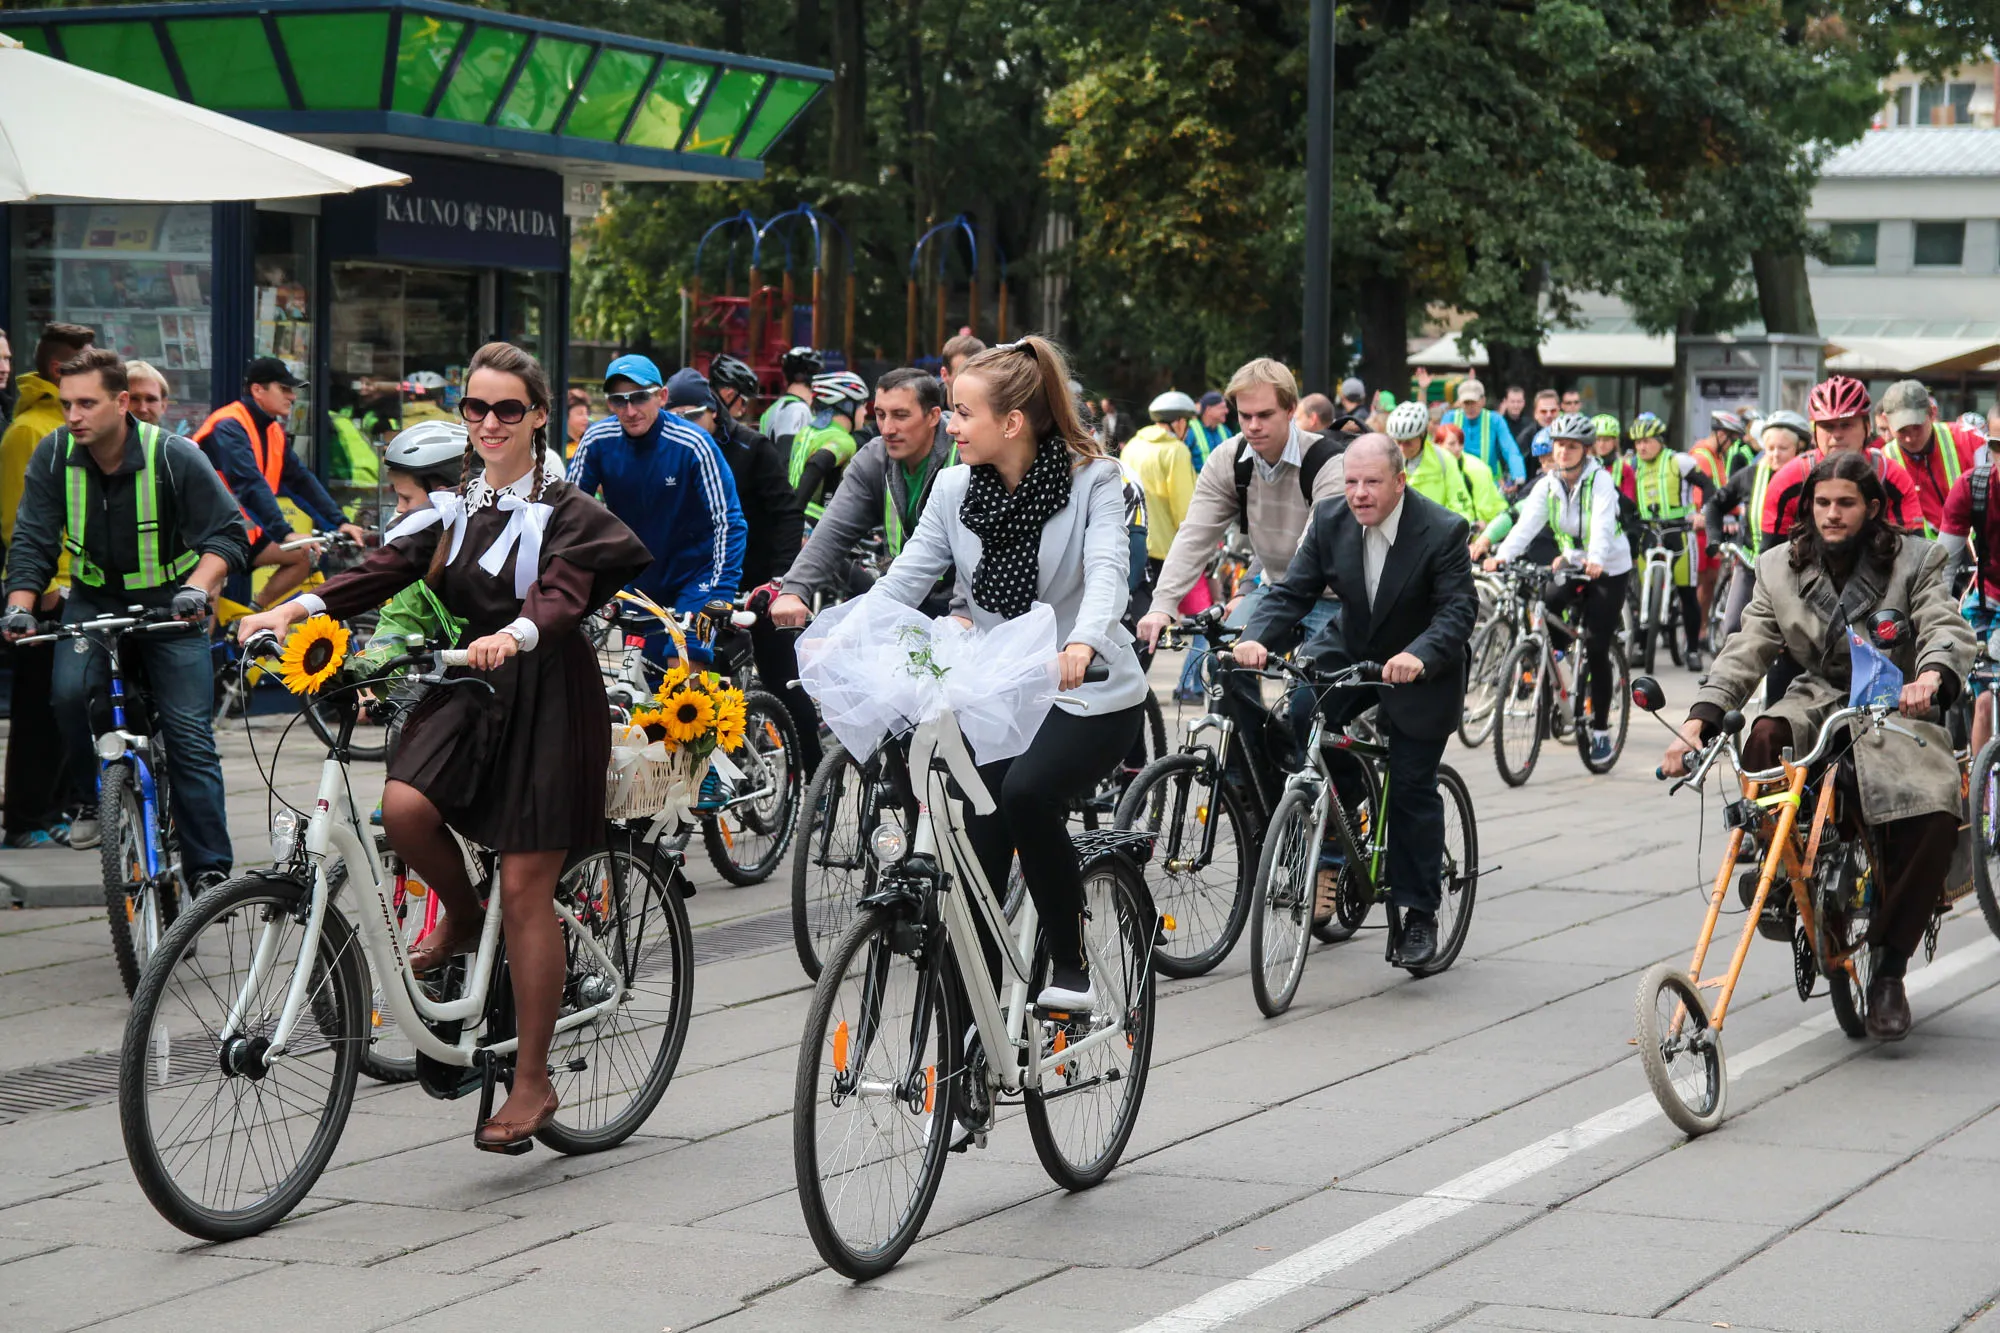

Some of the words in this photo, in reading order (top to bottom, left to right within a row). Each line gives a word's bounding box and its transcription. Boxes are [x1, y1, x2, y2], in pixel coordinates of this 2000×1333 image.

[386, 194, 459, 228] KAUNO
[486, 205, 557, 238] SPAUDA
[378, 893, 403, 967] PANTHER
